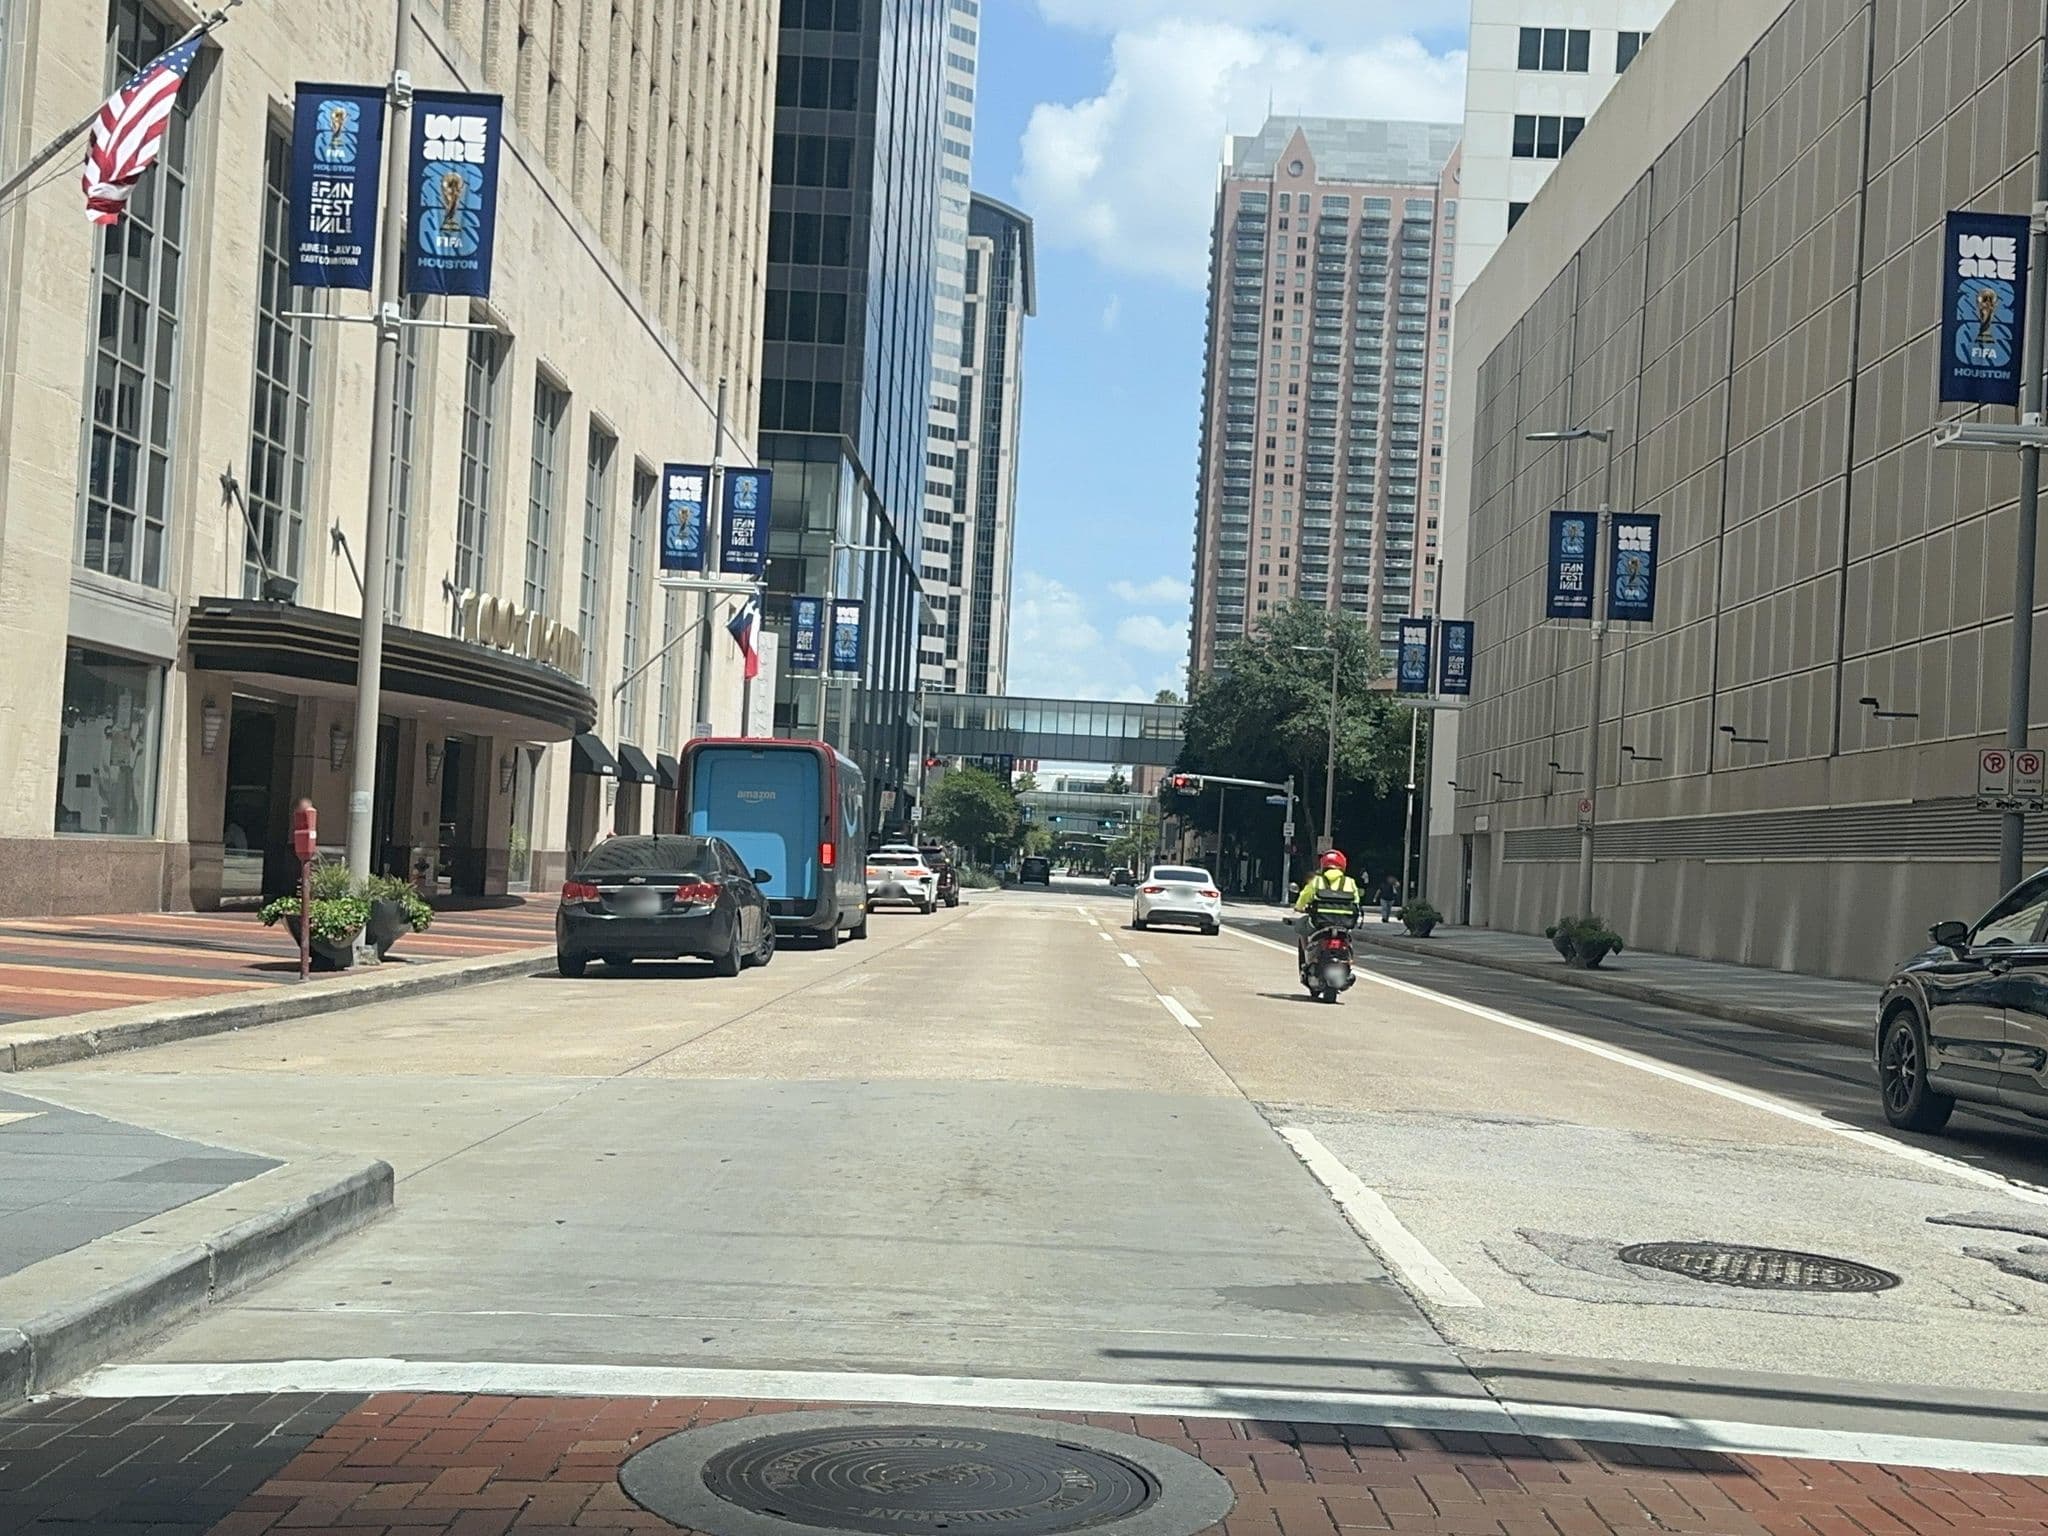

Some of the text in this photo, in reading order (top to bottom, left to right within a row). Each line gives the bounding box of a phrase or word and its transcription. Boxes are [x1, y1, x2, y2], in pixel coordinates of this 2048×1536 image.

[425, 114, 488, 143] WE
[423, 140, 485, 163] ARE
[319, 181, 354, 199] FAN
[311, 198, 354, 217] FEST
[299, 242, 319, 254] JUNE
[334, 245, 351, 255] JULY
[436, 235, 464, 249] FIFA
[1958, 234, 2016, 261] WE
[418, 257, 478, 270] HOUSTON
[1957, 259, 2016, 280] ARE
[1971, 347, 1998, 359] FIFA
[1954, 367, 2011, 380] HOUSTON
[737, 790, 776, 800] amazon
